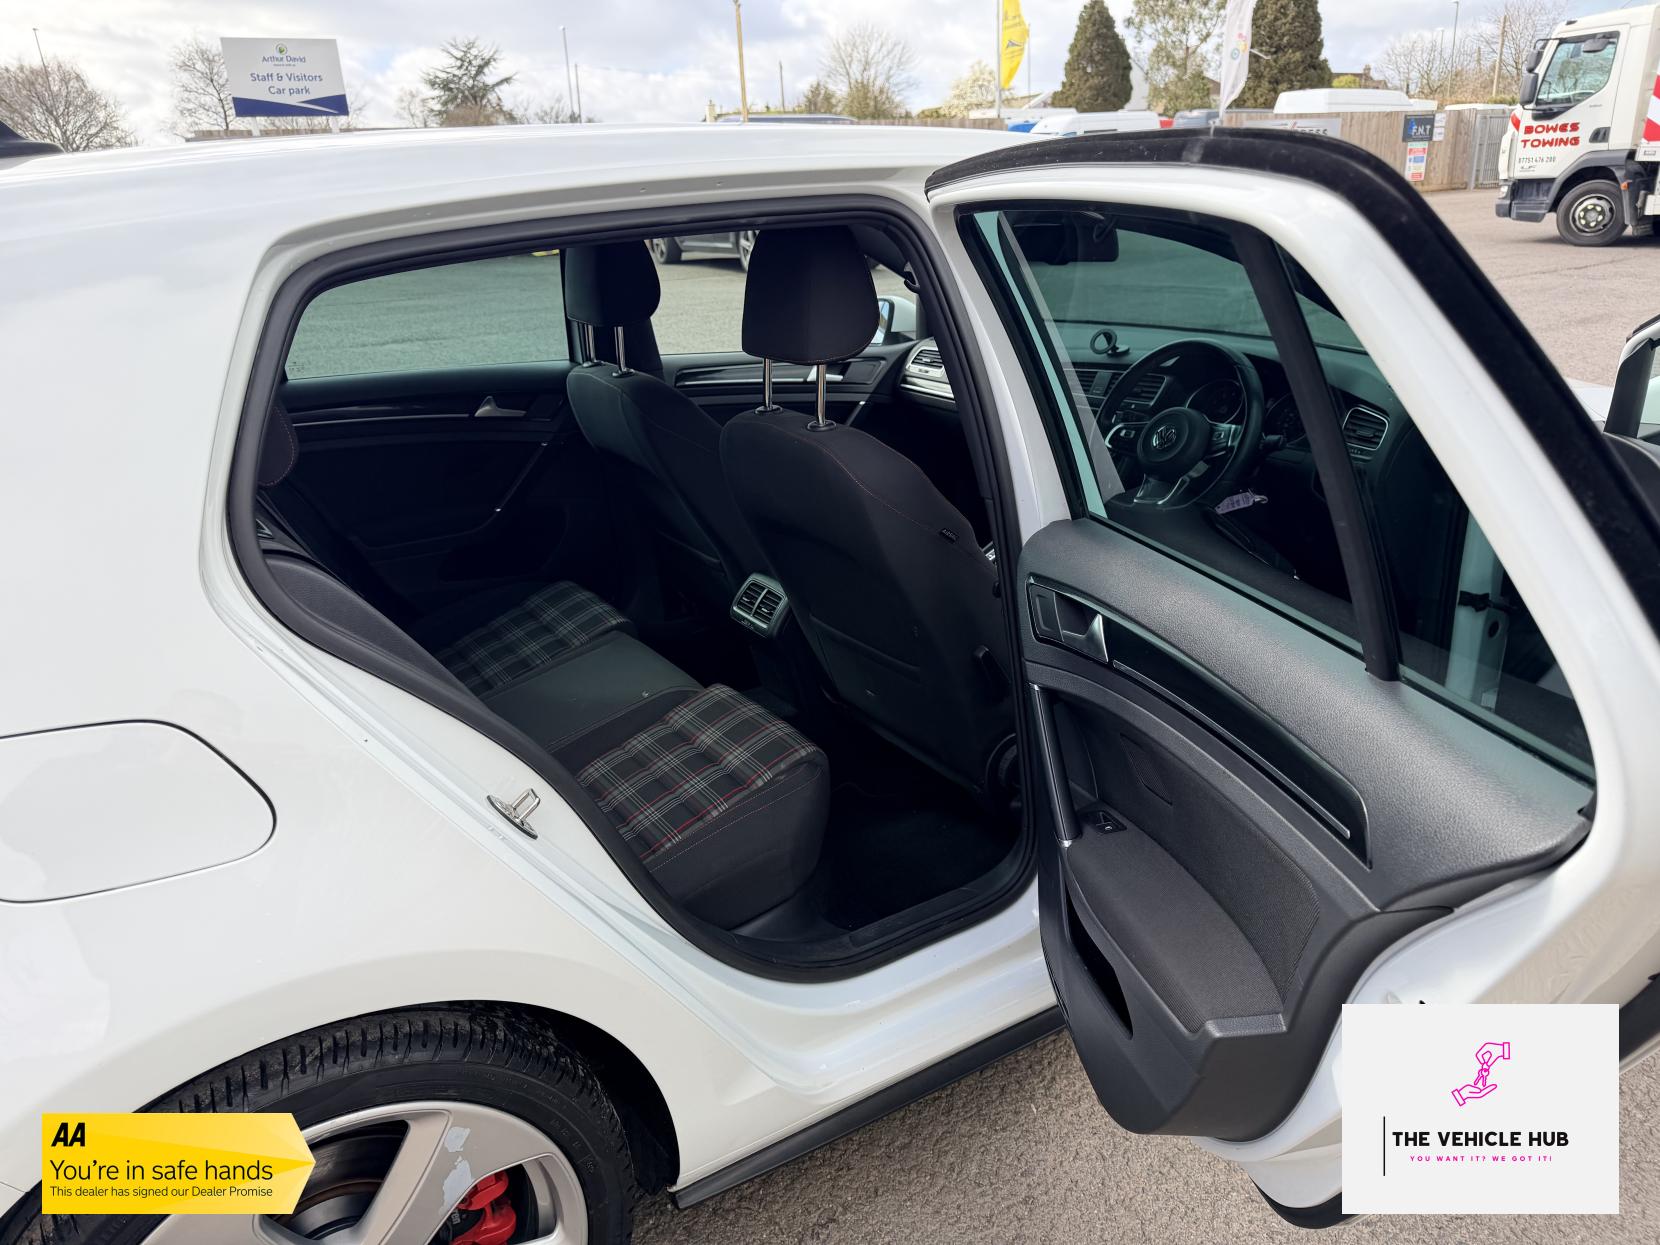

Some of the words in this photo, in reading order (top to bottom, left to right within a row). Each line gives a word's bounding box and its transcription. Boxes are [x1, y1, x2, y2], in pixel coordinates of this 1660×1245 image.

[250, 73, 273, 82] Staff
[276, 73, 284, 82] &
[286, 73, 323, 82] Visitors
[268, 86, 286, 95] Car
[288, 86, 311, 96] park
[1524, 122, 1580, 135] BOWES
[1520, 136, 1580, 149] TOWING
